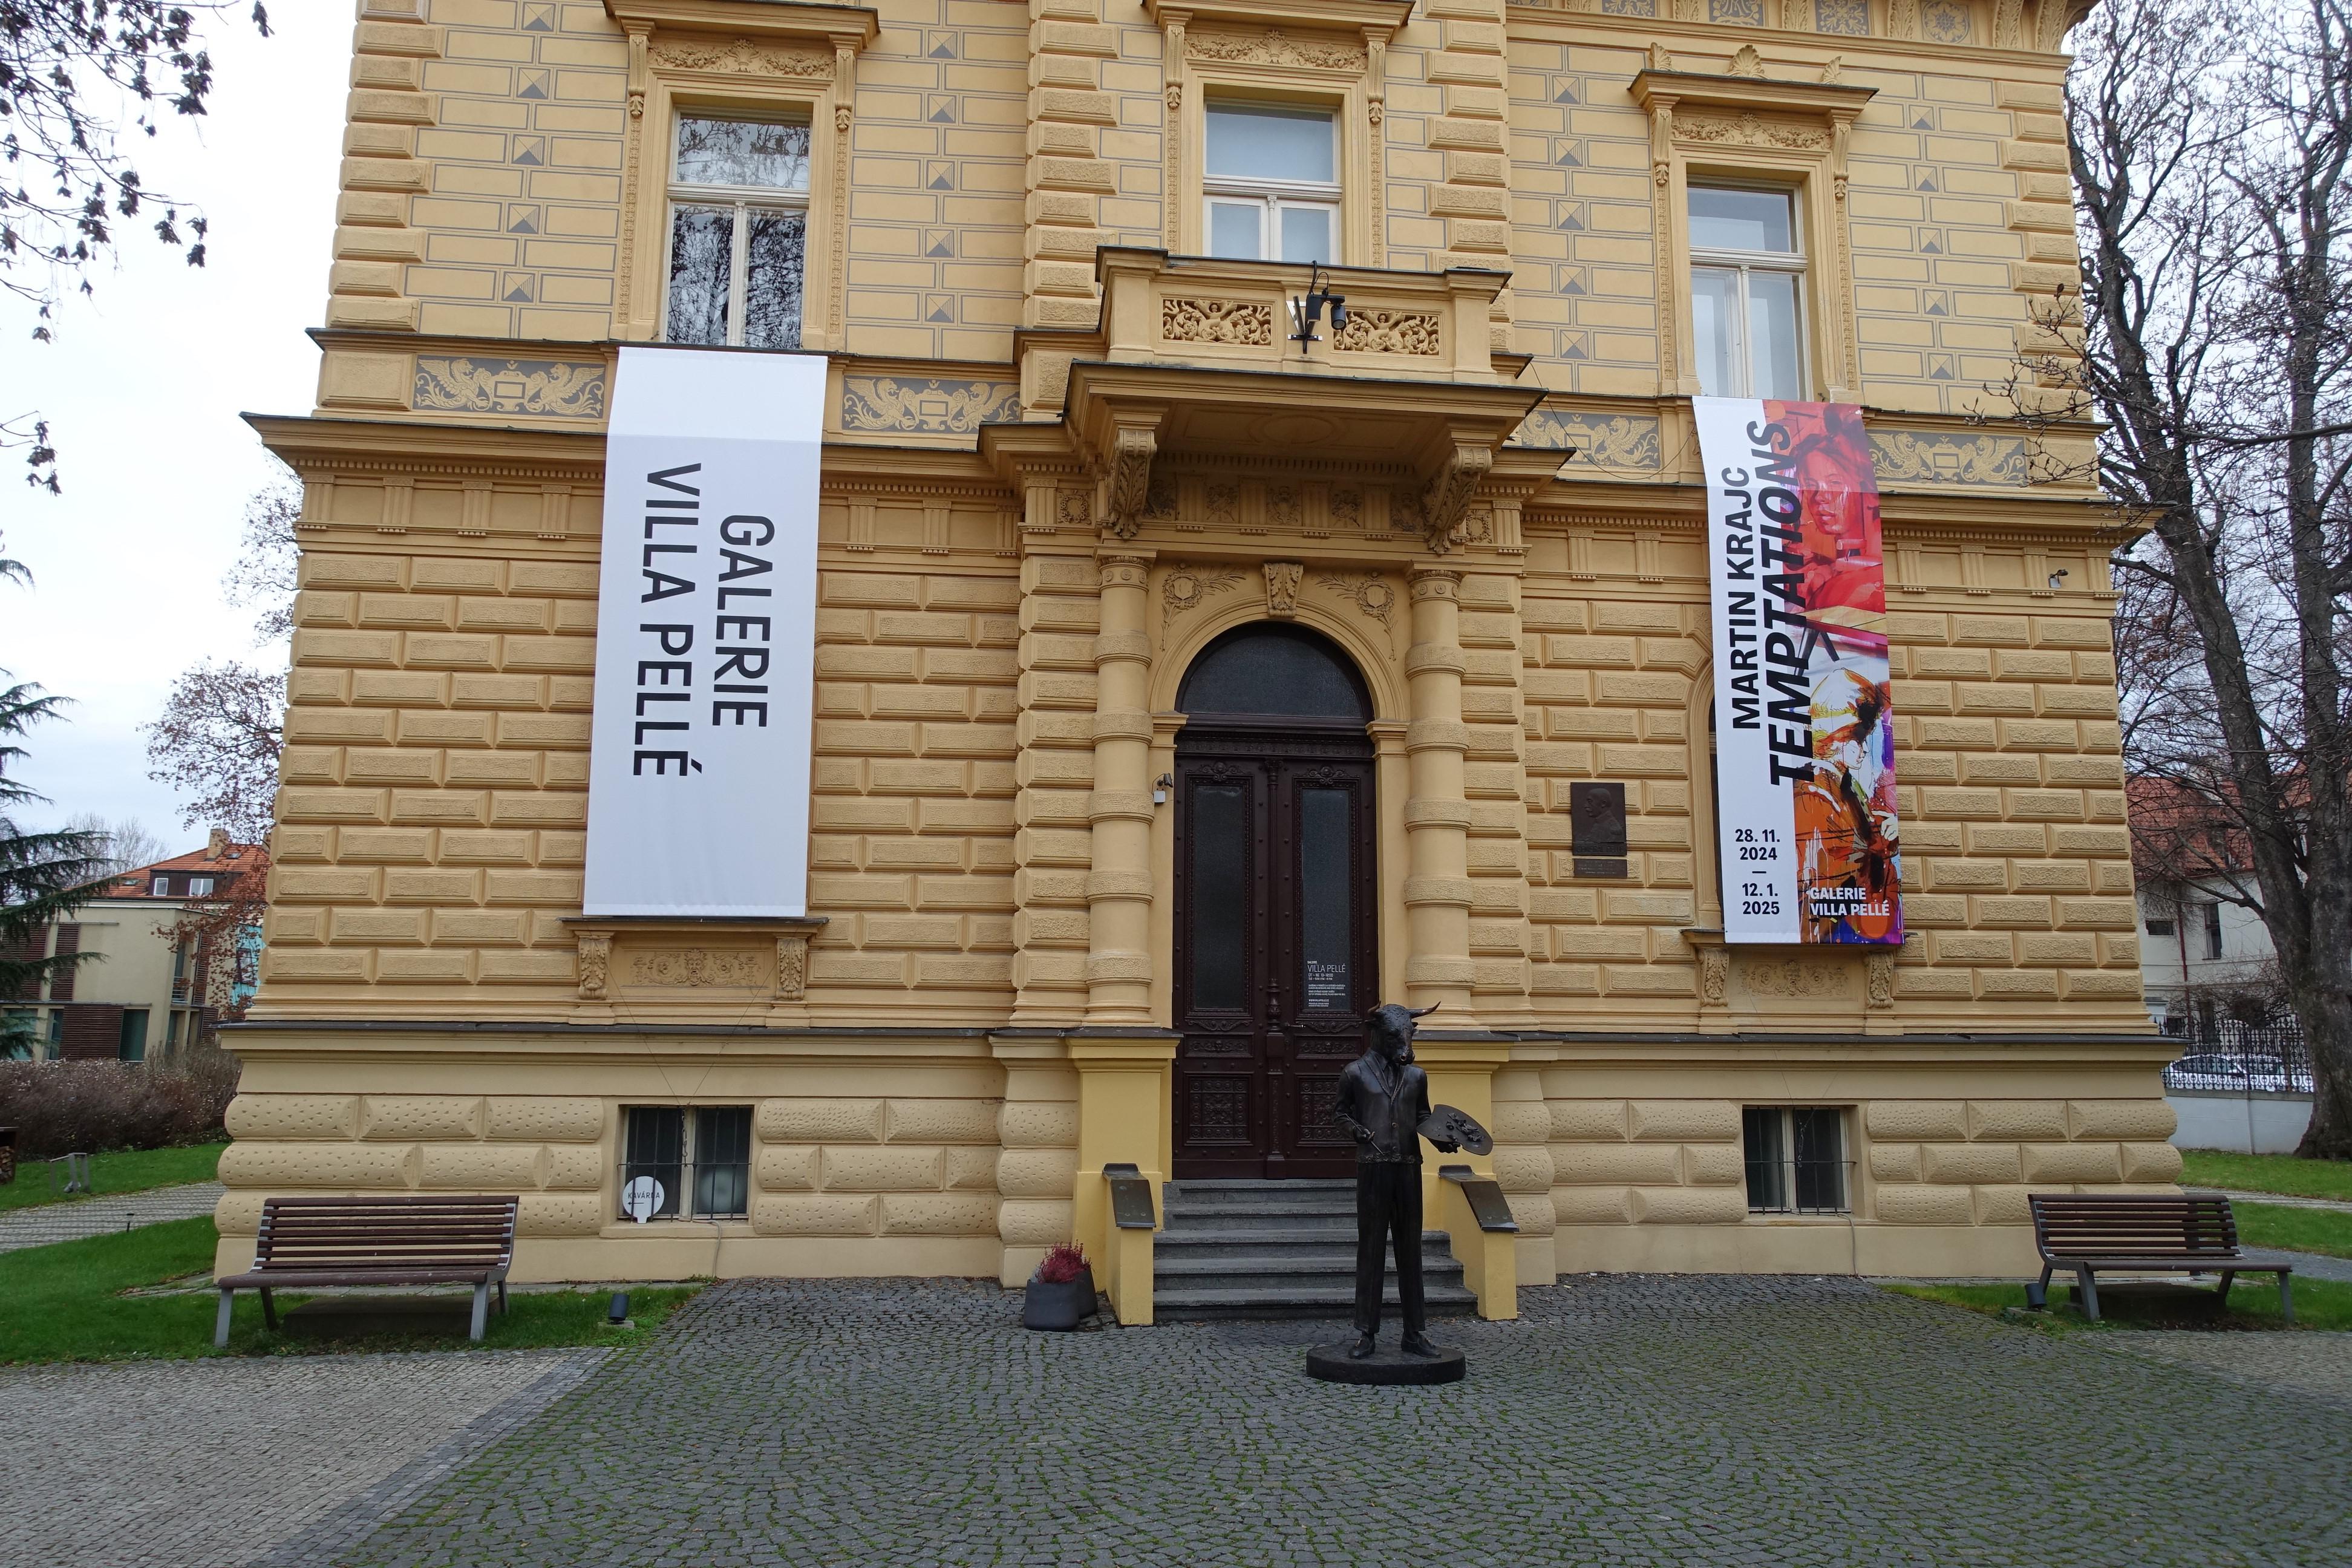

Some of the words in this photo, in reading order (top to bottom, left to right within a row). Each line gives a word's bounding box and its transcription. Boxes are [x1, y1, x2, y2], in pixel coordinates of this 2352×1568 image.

[1721, 467, 1754, 580] KRAJC
[641, 463, 701, 604] VILLA
[1746, 421, 1815, 786] TEMPTATIONS
[712, 515, 775, 728] GALERIE
[1728, 592, 1760, 729] MARTIN
[633, 624, 702, 776] PELLÉ
[1735, 829, 1758, 842] 28.
[1762, 829, 1780, 842] 11.
[1740, 847, 1777, 860] 2024
[1742, 883, 1763, 897] 12.
[1766, 883, 1778, 897] 1.
[1810, 887, 1866, 900] GALERIE
[1742, 901, 1780, 915] 2025
[1810, 903, 1847, 916] VILLA
[1851, 900, 1890, 916] PELLÉ
[1327, 964, 1346, 972] PELLÉ
